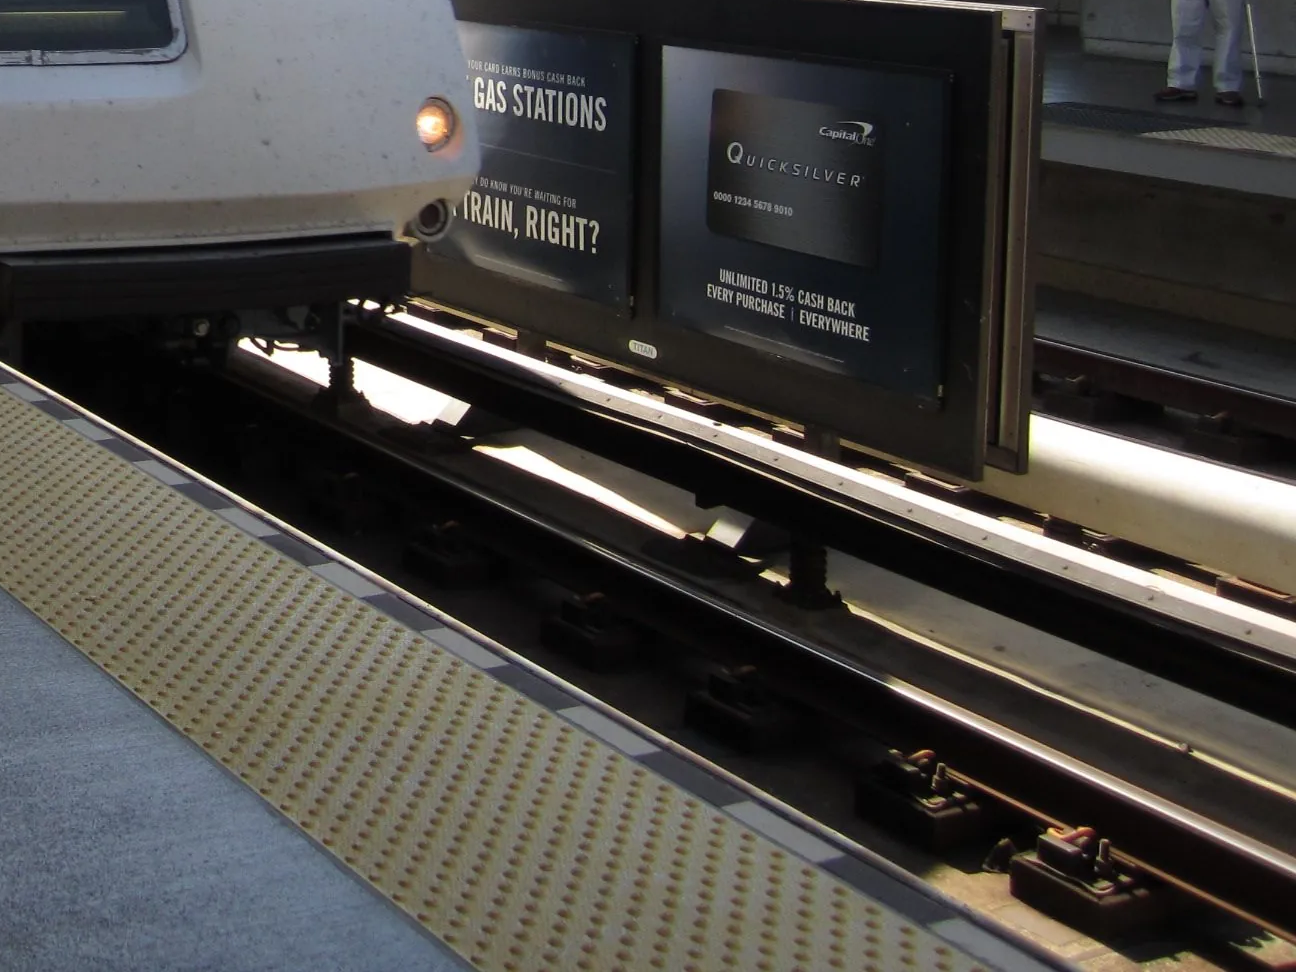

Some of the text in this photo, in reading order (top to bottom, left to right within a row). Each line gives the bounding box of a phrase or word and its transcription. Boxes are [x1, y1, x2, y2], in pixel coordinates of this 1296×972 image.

[468, 59, 586, 87] YOUR CARD EARNS BONUS CASH BACK
[474, 76, 607, 132] GAS STATIONS
[726, 141, 862, 188] QUICKSILVER
[480, 176, 489, 188] DO
[489, 179, 508, 193] KNOW
[510, 183, 533, 199] YOU'RE
[534, 190, 562, 206] WAITING
[563, 196, 577, 209] FOR
[713, 190, 794, 217] 0000 1234 5678 9010
[463, 190, 600, 254] TRAIN, RIGHT?
[706, 283, 871, 343] EVERY PURCHASE EVERYWHERE
[719, 267, 856, 319] UNLIMITED 1.5% CASH BACK
[632, 342, 655, 356] TITAN
